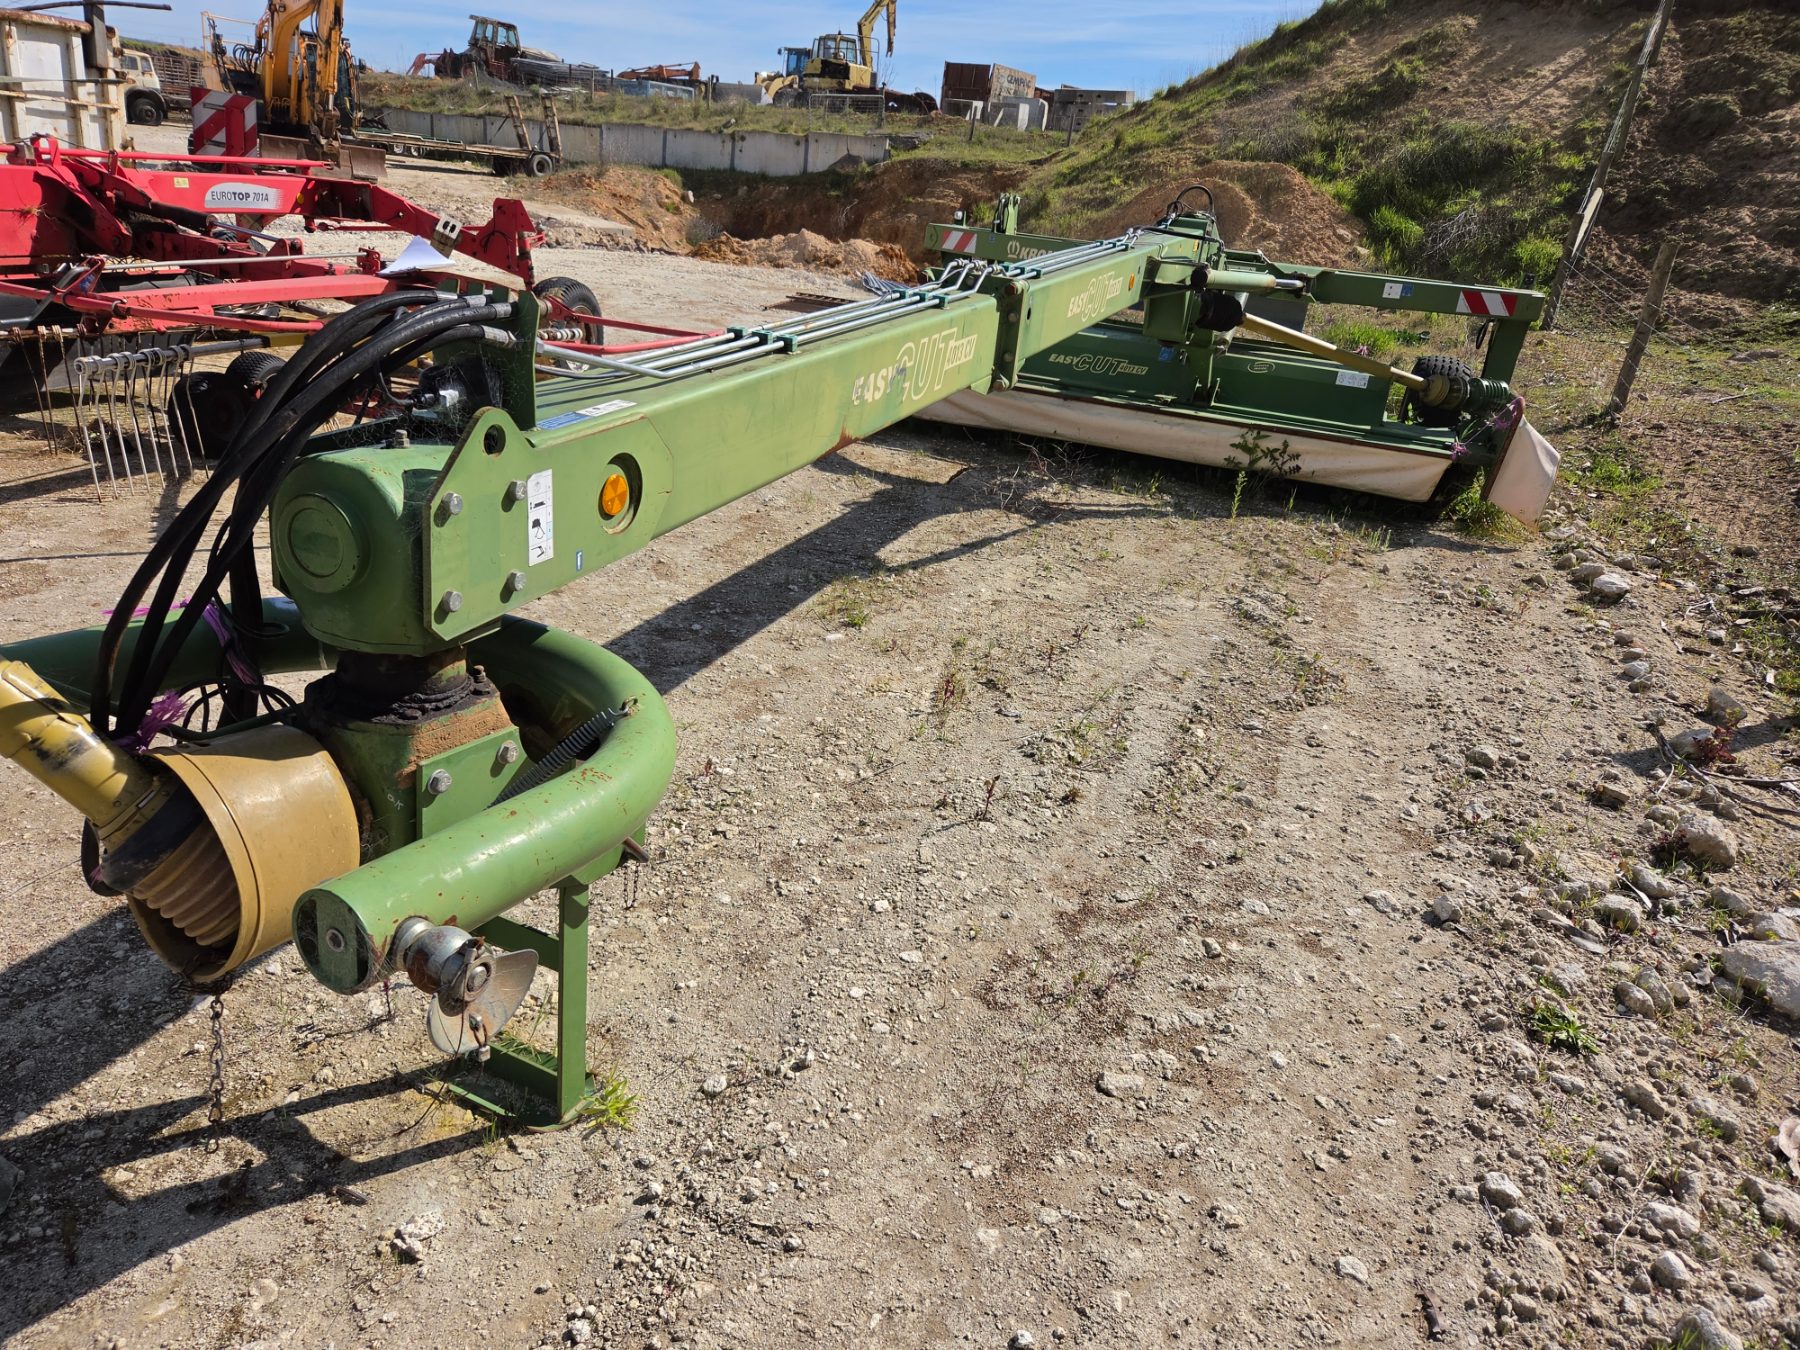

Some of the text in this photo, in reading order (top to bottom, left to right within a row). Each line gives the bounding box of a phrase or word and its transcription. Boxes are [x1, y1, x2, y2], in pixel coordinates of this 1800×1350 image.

[211, 191, 269, 202] EUROTOP 701A
[1019, 247, 1057, 260] KRO
